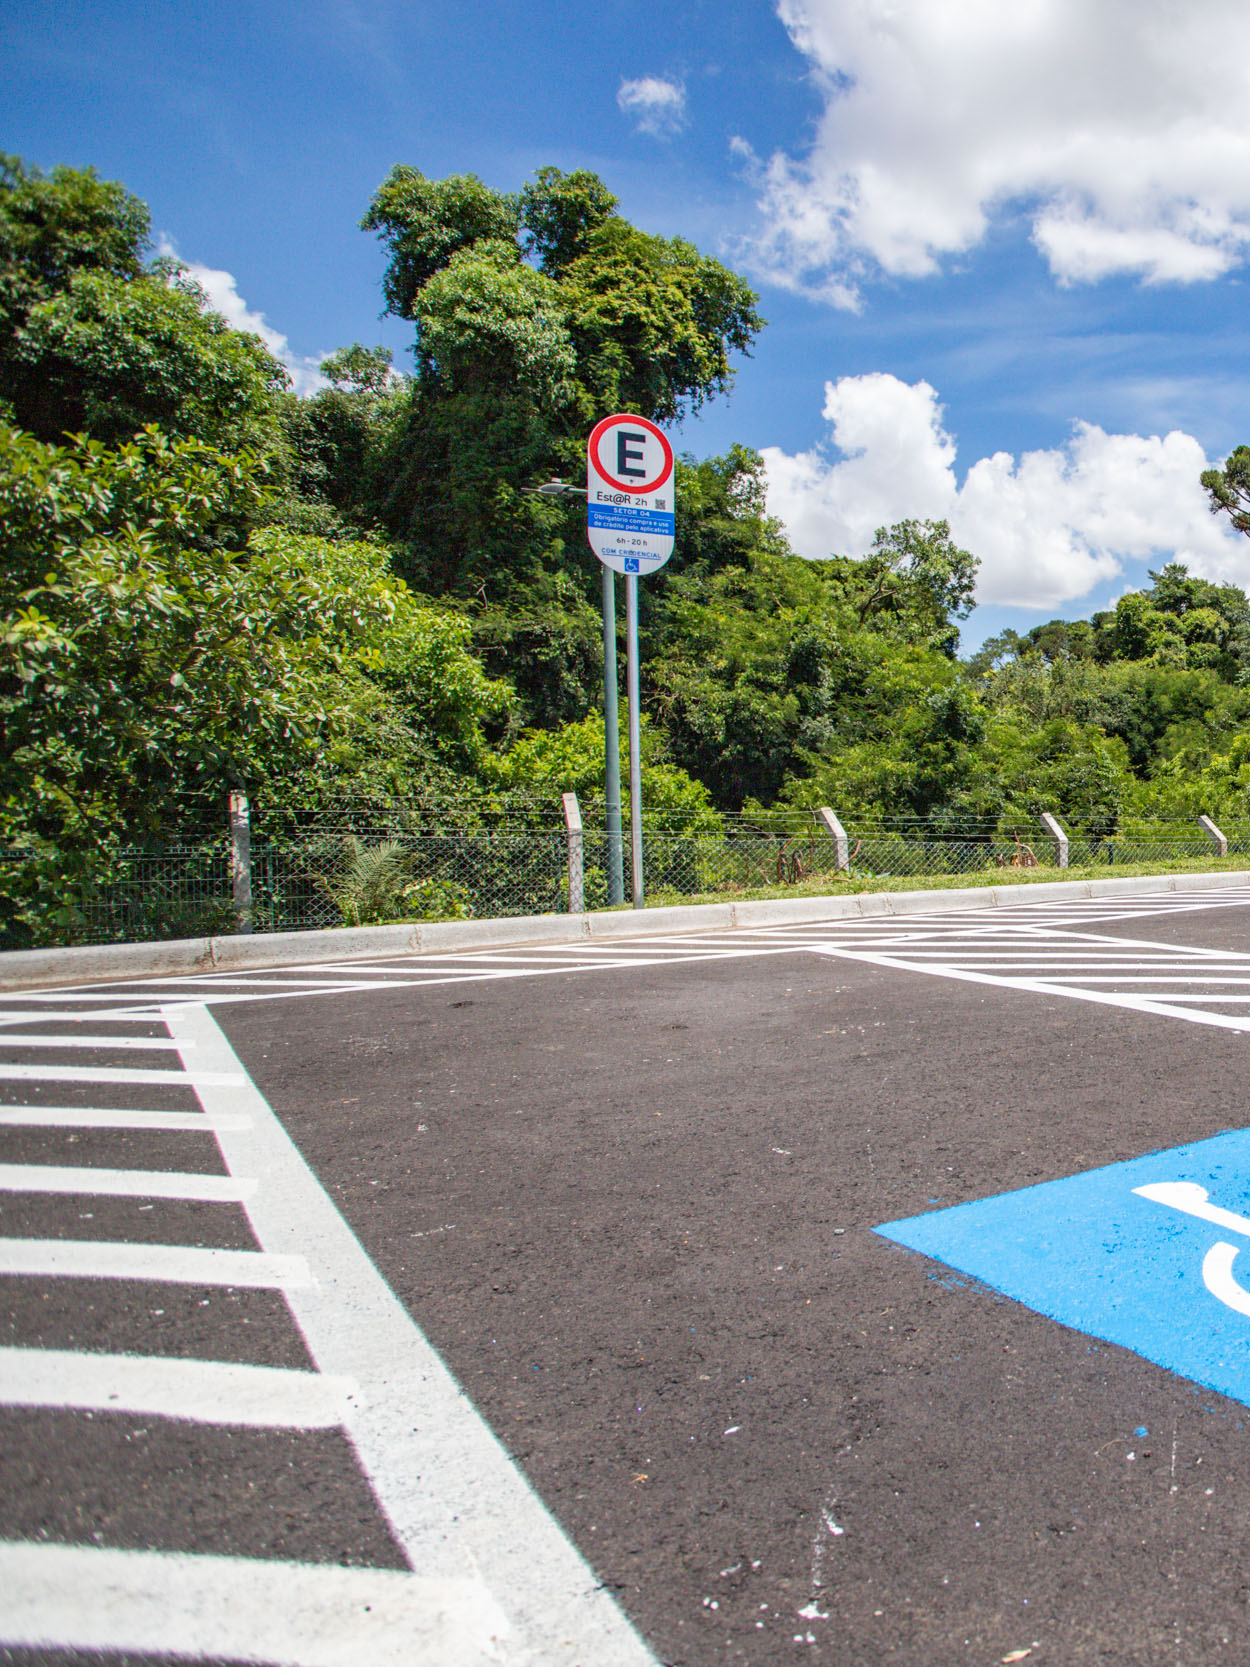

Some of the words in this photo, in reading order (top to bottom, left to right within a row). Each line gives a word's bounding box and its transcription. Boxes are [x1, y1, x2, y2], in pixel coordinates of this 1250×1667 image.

[617, 431, 646, 478] E
[597, 491, 631, 505] Est@R
[635, 498, 648, 506] 2h
[613, 507, 637, 515] SETOR
[618, 549, 662, 559] CREDENCIAL
